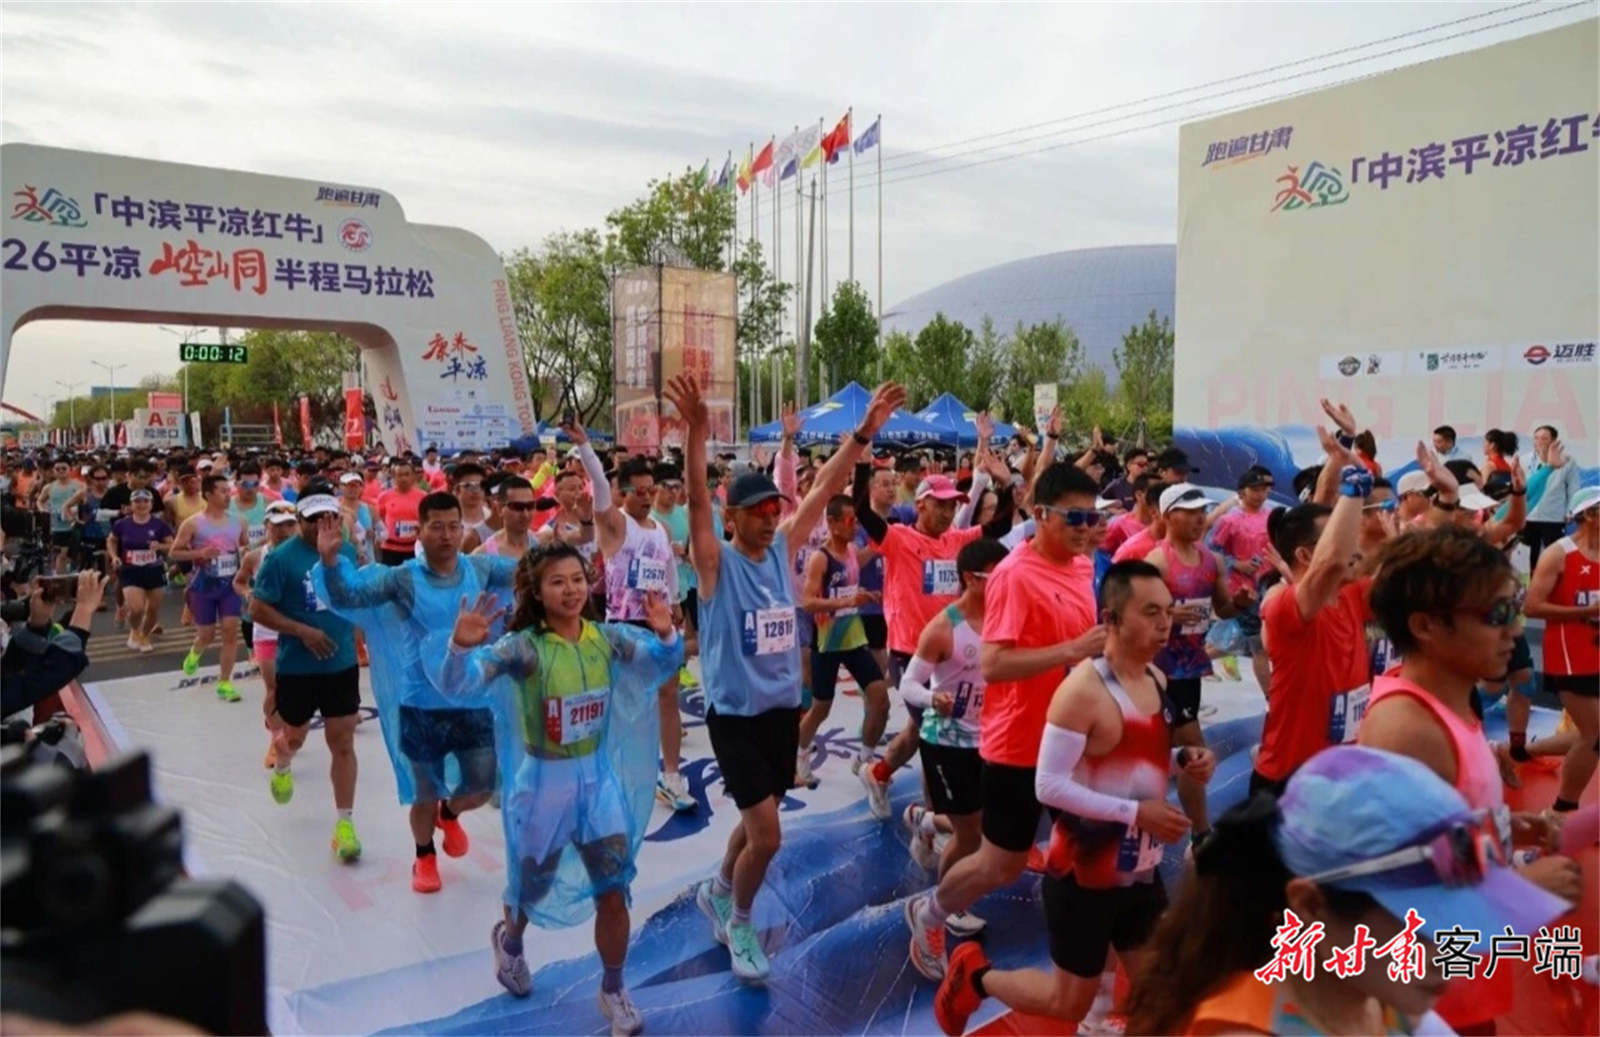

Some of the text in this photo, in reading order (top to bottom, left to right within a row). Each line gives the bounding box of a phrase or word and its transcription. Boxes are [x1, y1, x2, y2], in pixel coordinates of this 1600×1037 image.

[1201, 125, 1294, 167] 跑遍甘肃
[1352, 113, 1599, 190] 「中滨平凉红
[94, 192, 324, 244] 「中滨平凉红牛」
[184, 345, 244, 362] 0:00:12
[500, 317, 519, 363] LIANG
[509, 363, 528, 405] KONG
[744, 611, 755, 630] A
[548, 699, 559, 718] A
[570, 701, 604, 726] 21191
[1334, 694, 1345, 716] A
